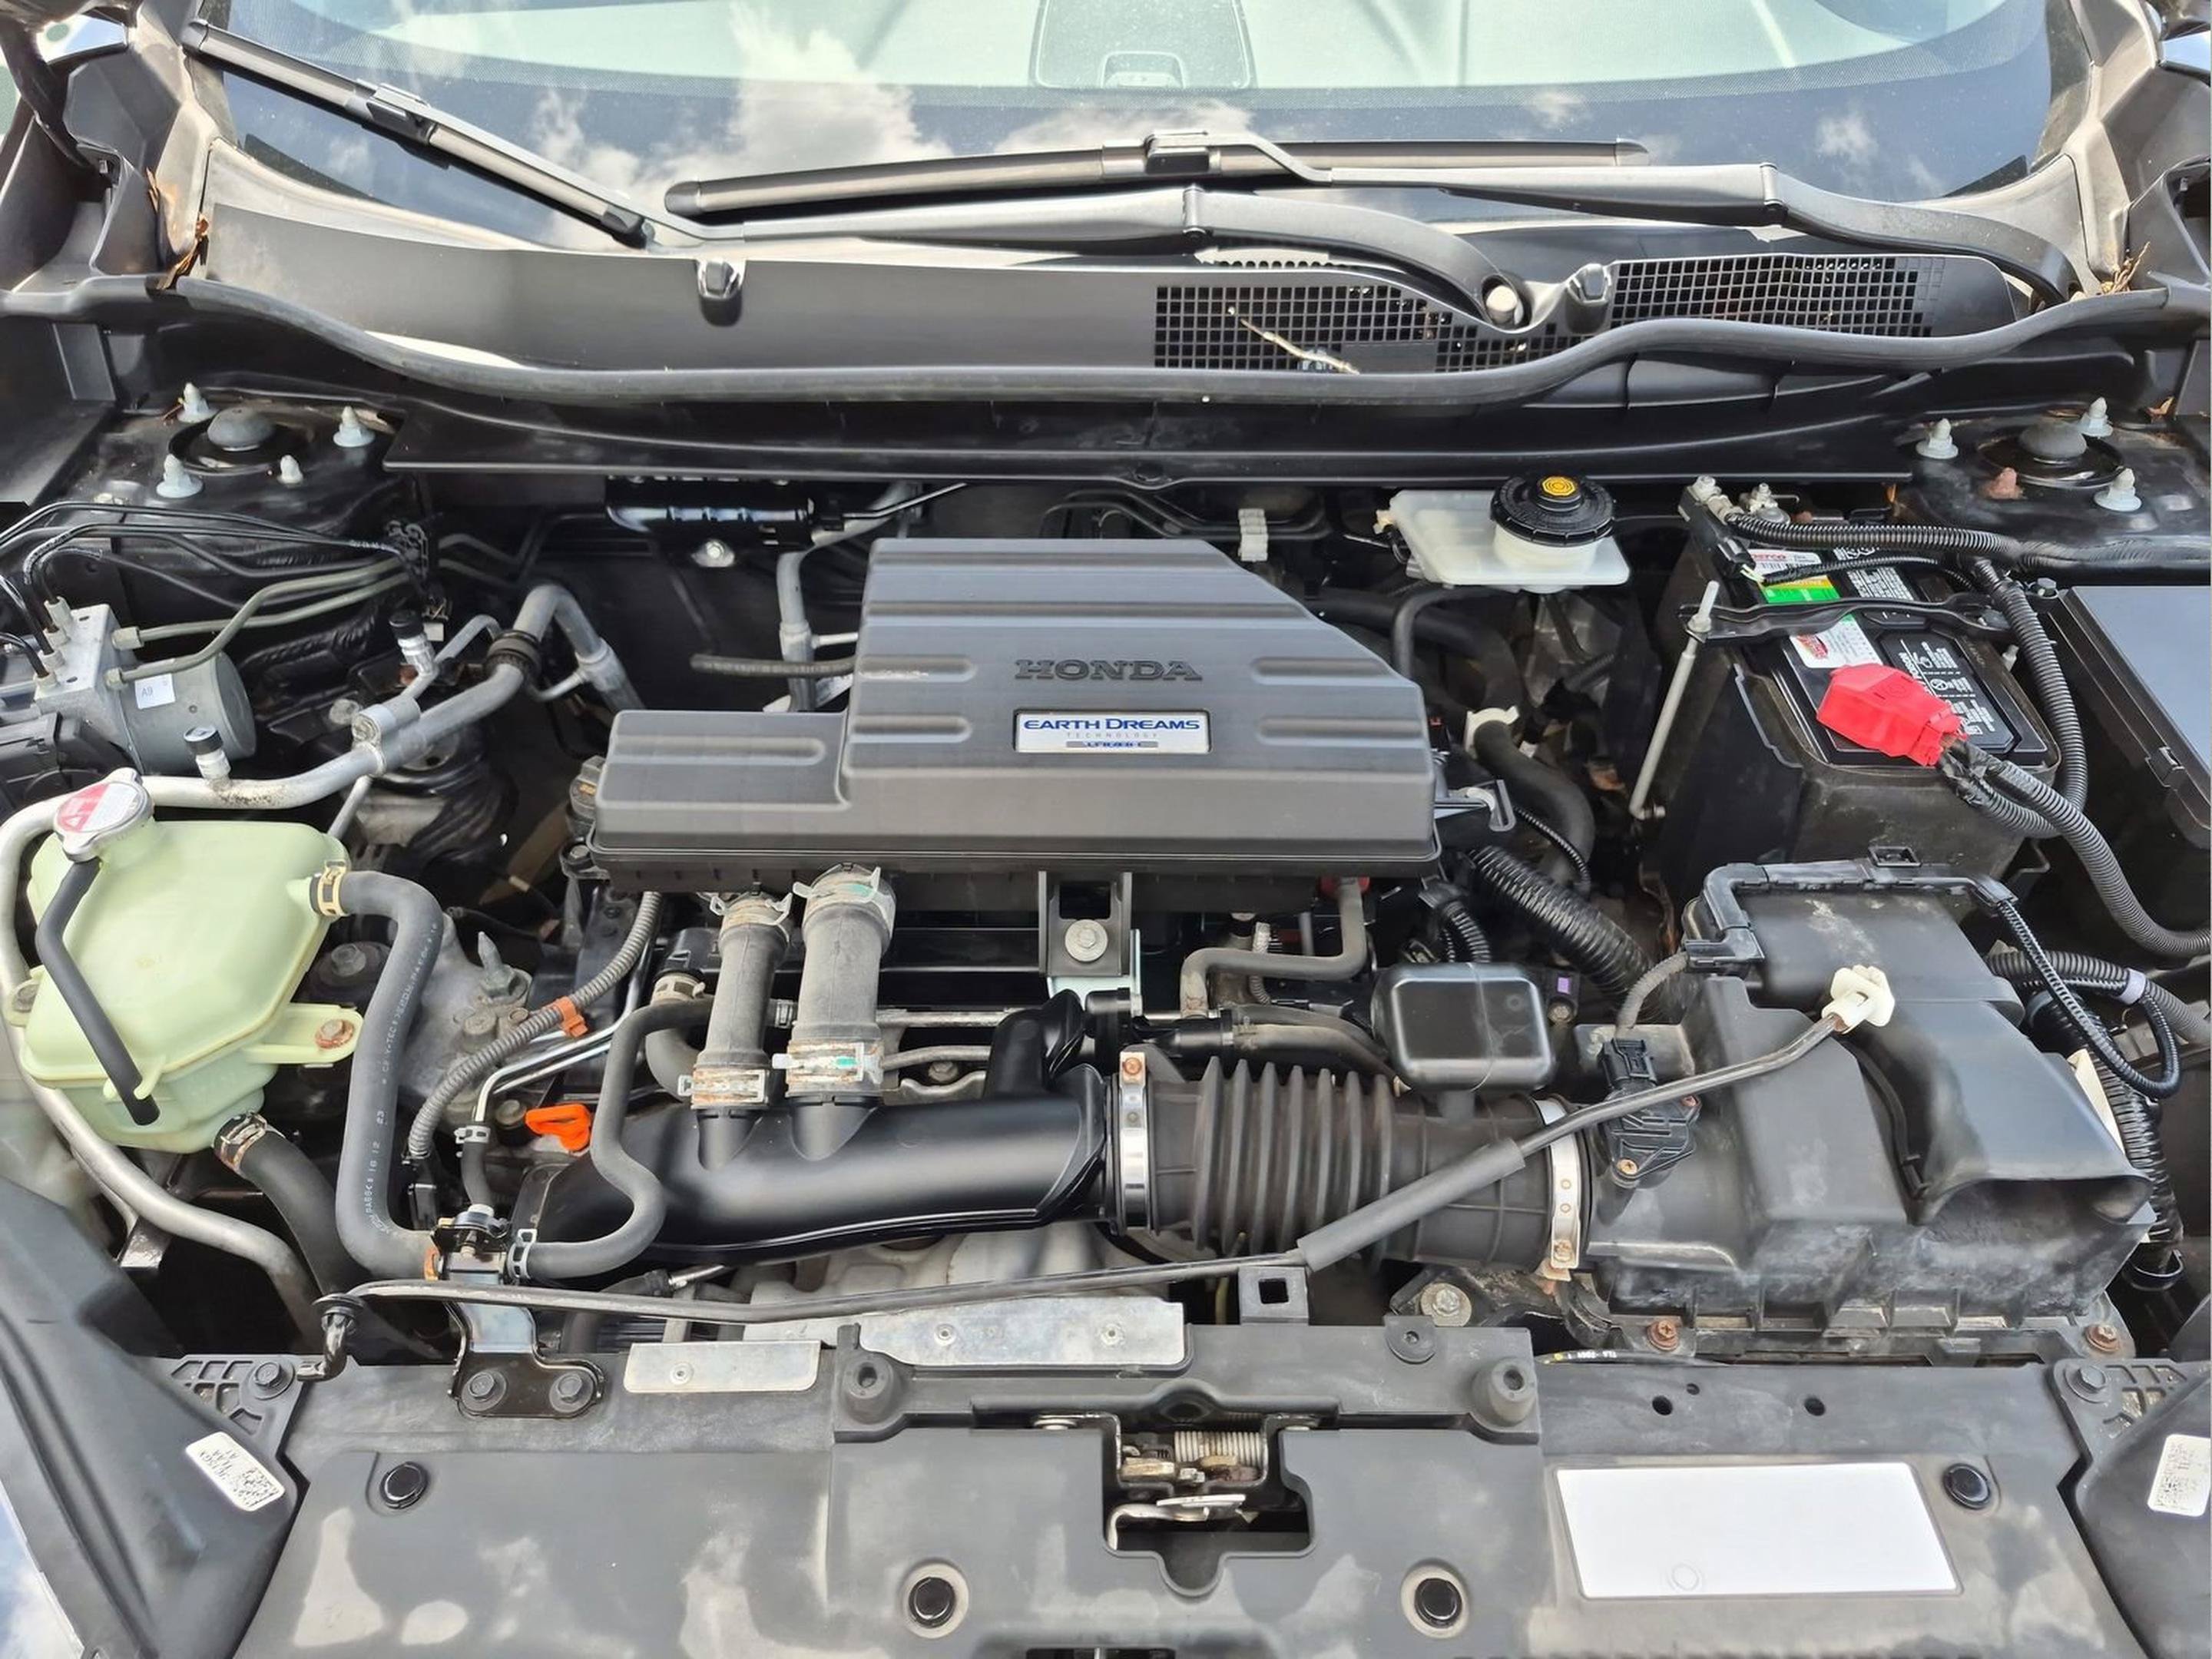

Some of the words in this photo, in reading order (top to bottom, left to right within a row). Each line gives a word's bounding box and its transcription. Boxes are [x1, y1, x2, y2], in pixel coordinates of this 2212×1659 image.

[1015, 659, 1203, 681] HONDA
[1024, 720, 1100, 730] EARTH
[1105, 718, 1200, 730] DREAMS
